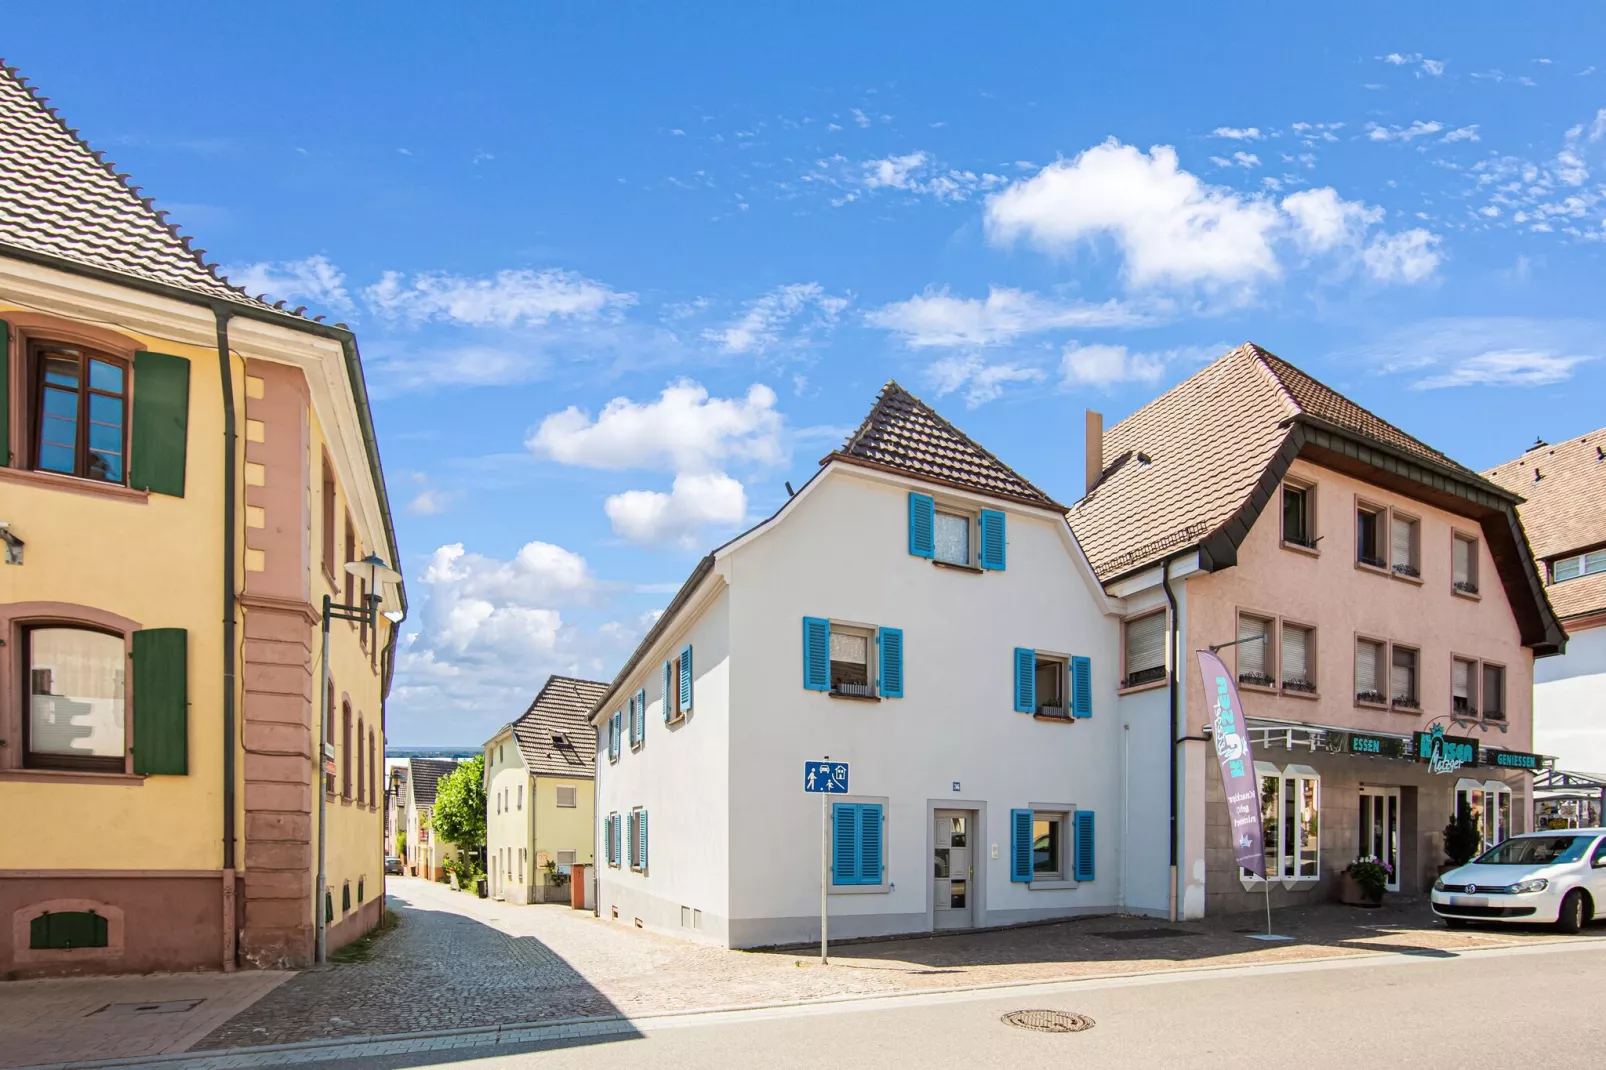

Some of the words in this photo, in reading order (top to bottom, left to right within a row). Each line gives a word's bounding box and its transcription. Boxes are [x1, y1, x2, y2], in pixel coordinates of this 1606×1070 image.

[1353, 737, 1380, 753] ESSEN
[1428, 742, 1464, 774] Metzger
[1497, 753, 1536, 768] GENIESSEN
